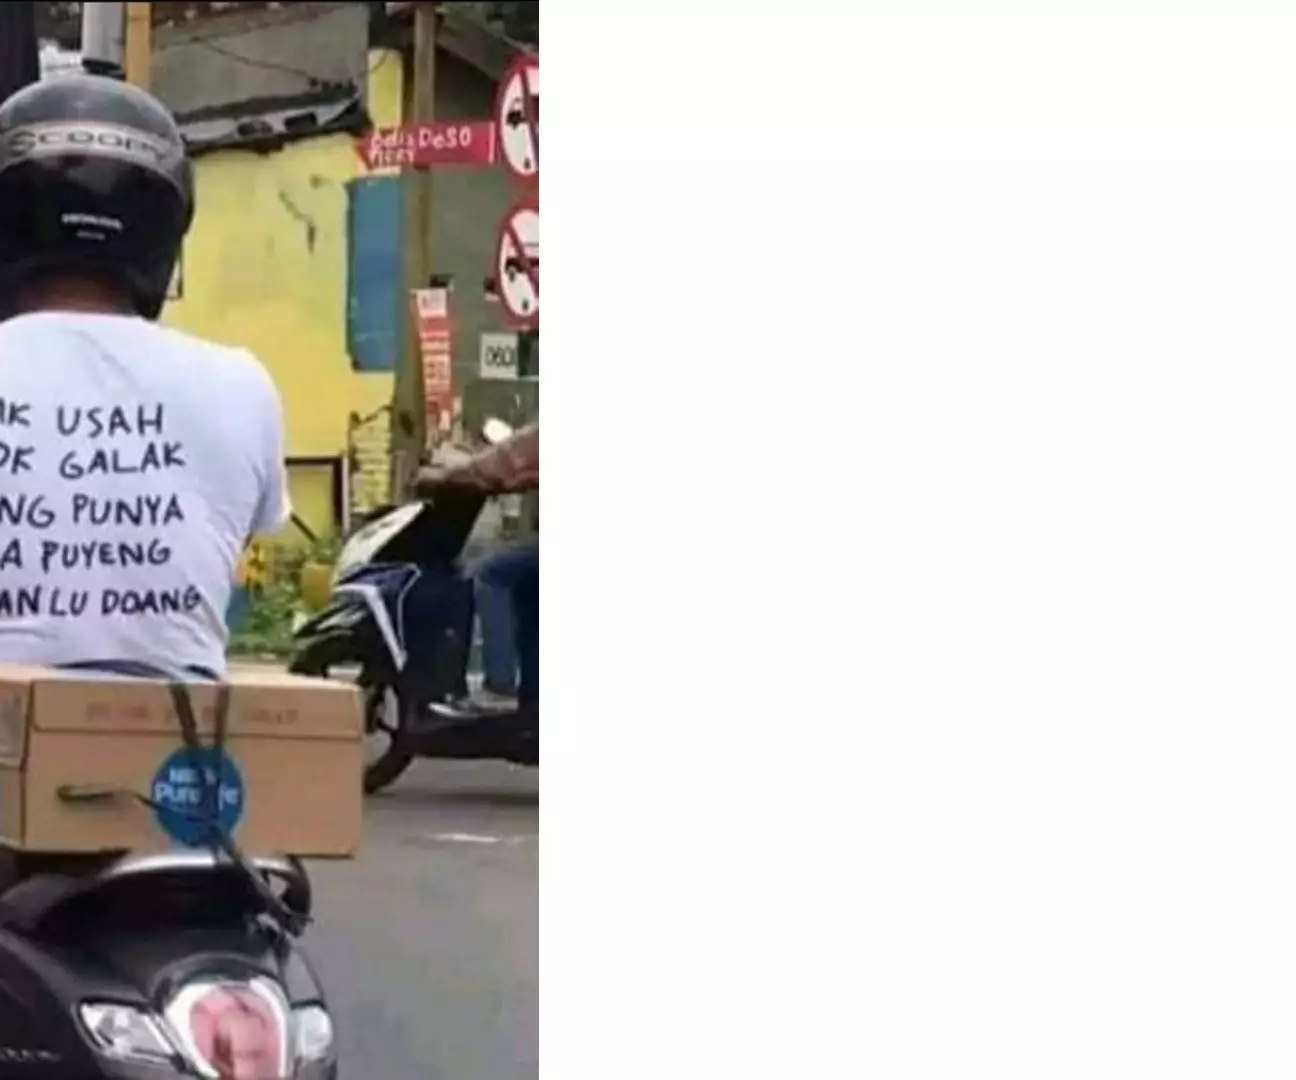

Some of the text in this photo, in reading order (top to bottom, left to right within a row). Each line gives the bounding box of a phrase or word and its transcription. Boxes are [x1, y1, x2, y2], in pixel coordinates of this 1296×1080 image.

[57, 403, 163, 438] USAH
[59, 442, 185, 480] GALAK
[72, 492, 184, 526] PUNYA
[40, 538, 172, 573] PUYENG
[49, 587, 88, 617] LU
[101, 585, 205, 616] DOANG
